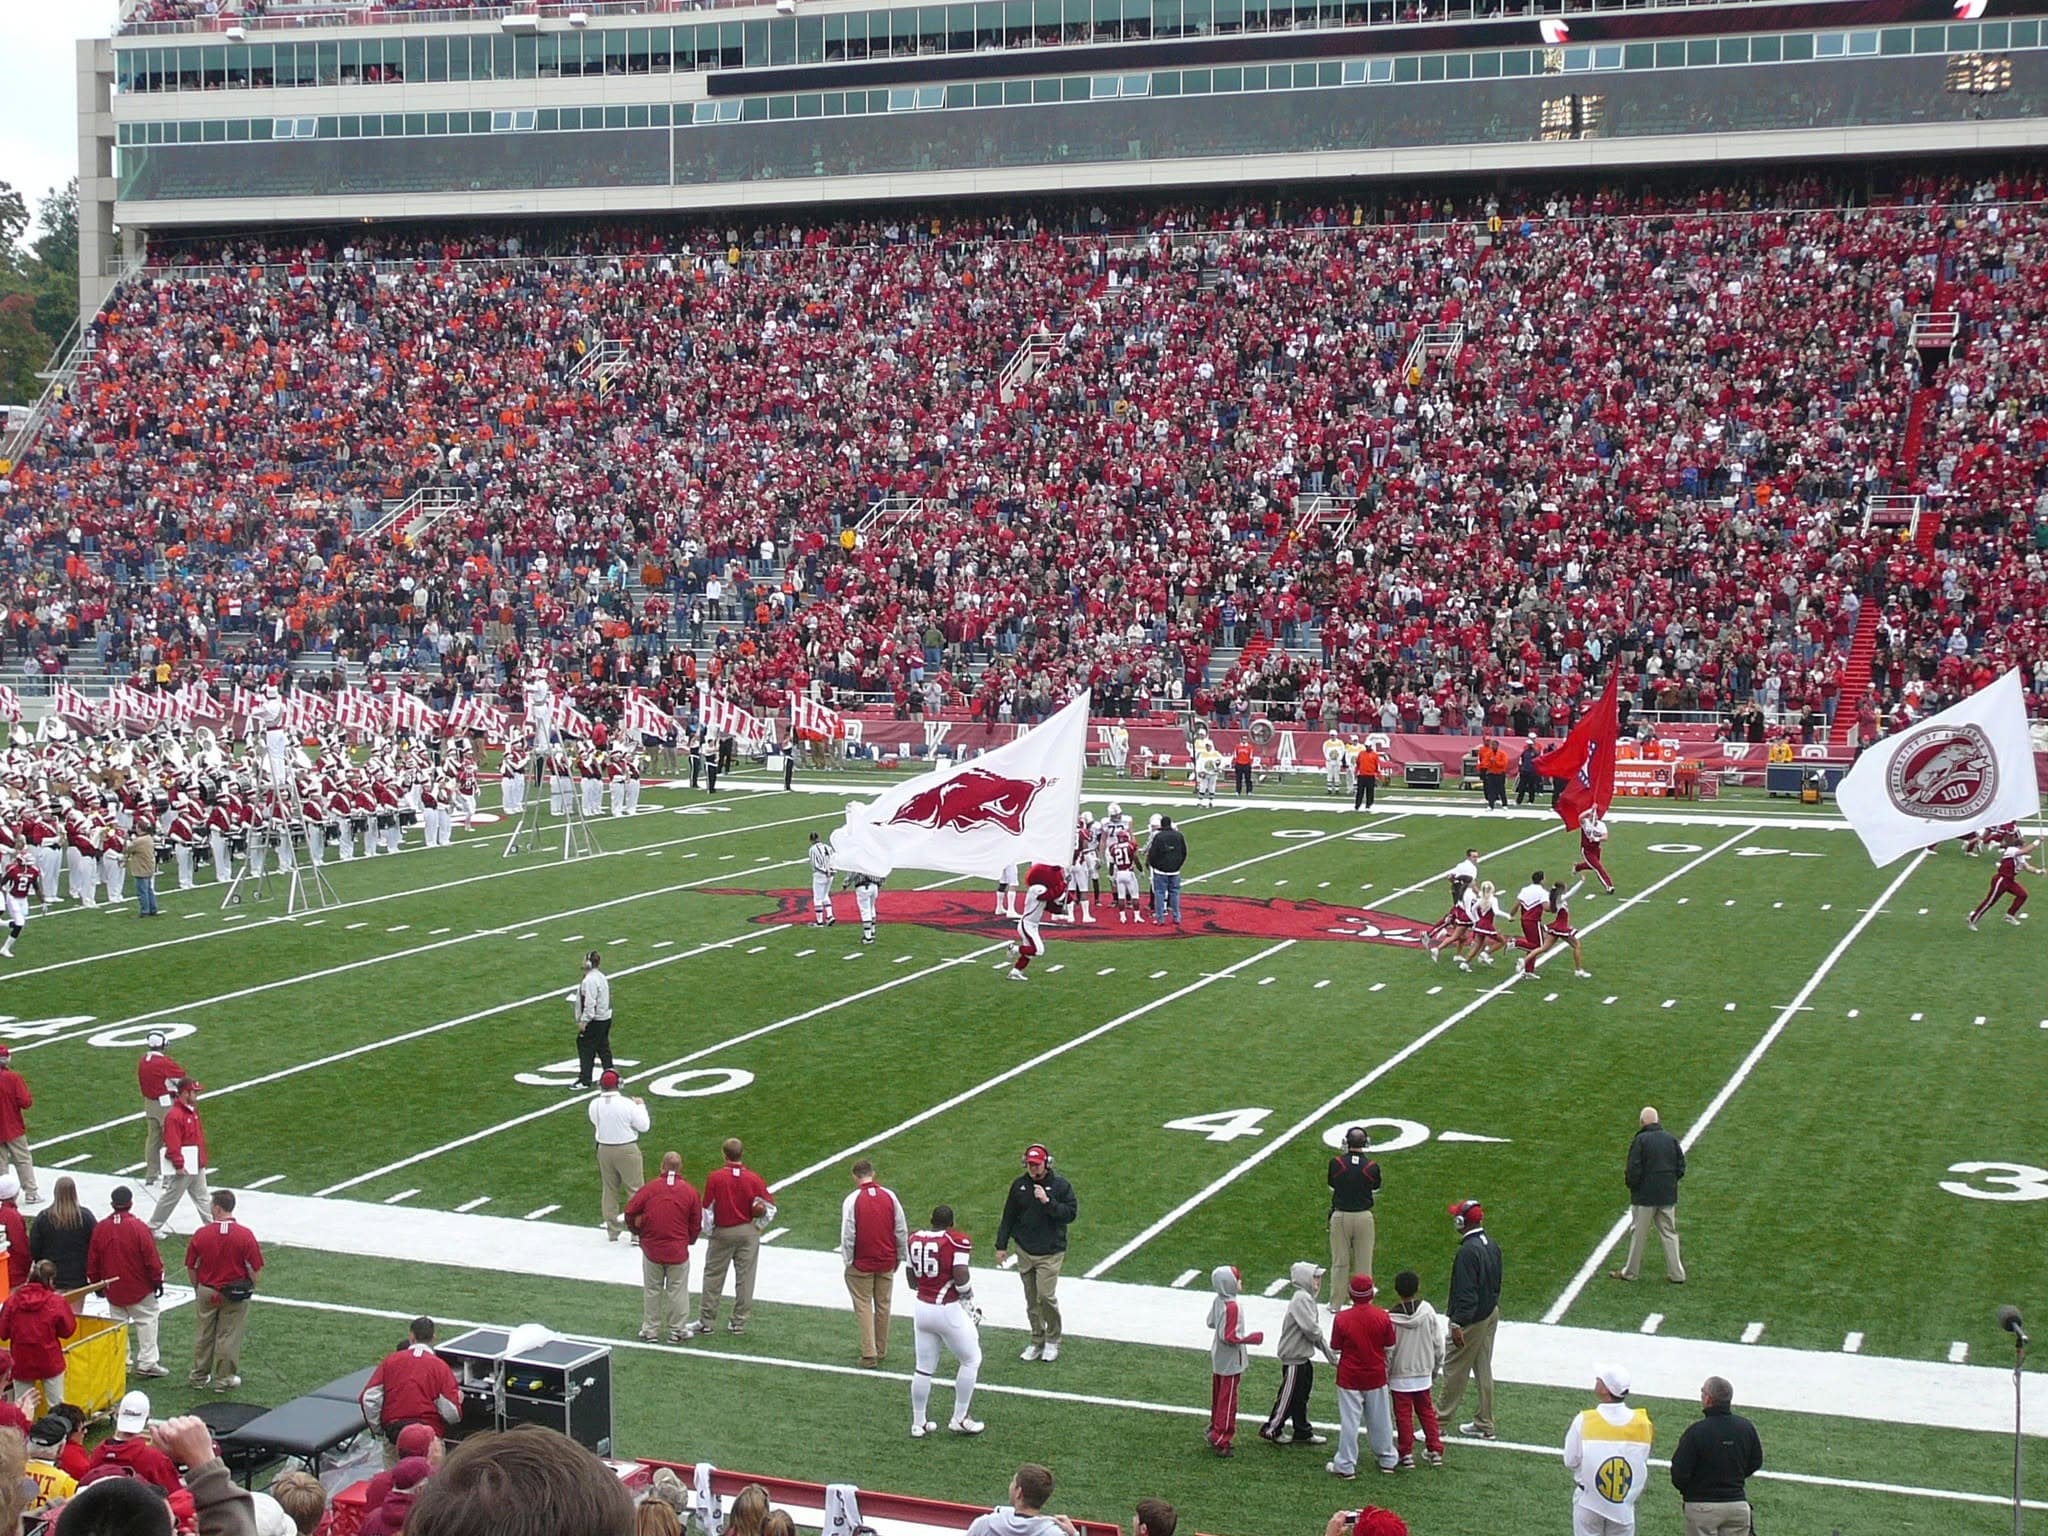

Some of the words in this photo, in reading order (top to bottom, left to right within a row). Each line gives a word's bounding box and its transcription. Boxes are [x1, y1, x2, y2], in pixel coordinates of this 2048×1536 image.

[1941, 783, 1968, 801] 100
[1114, 847, 1131, 866] 21
[17, 876, 29, 891] 2
[910, 1241, 939, 1278] 96
